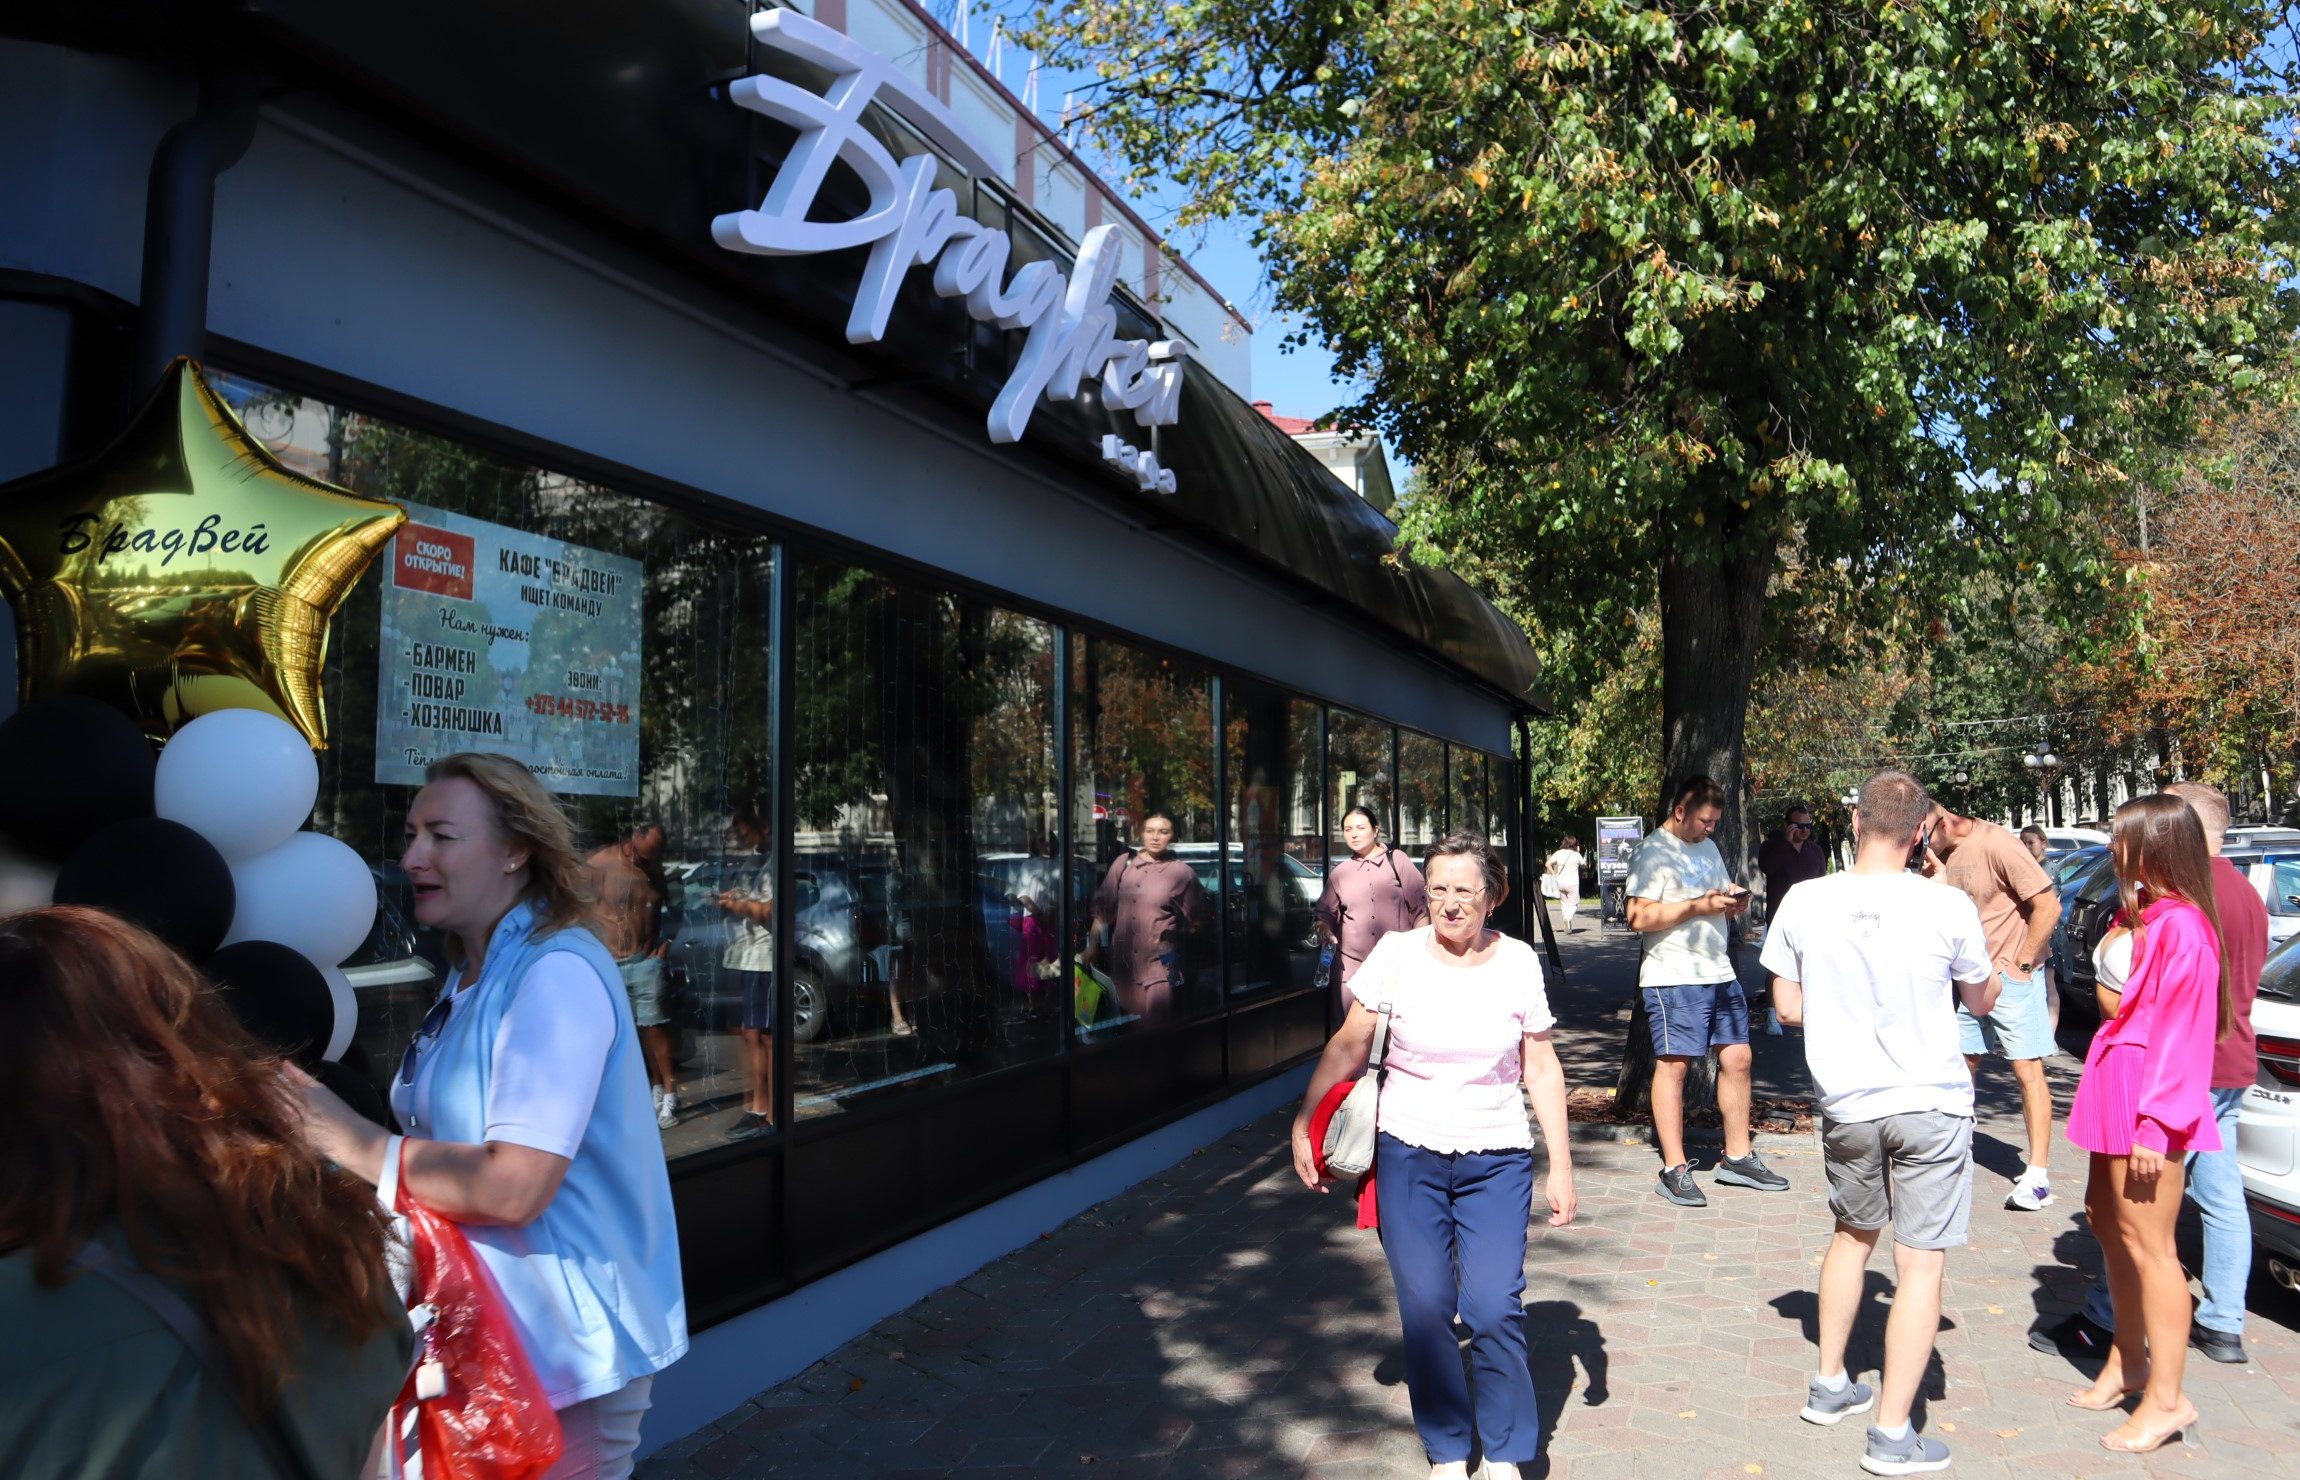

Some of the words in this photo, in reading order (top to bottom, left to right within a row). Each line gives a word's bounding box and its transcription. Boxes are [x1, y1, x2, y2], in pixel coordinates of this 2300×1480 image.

[416, 541, 452, 559] СКОРО
[404, 556, 465, 579] ОТКРЫТИЕ!
[499, 548, 541, 579] КАФЕ
[545, 558, 622, 595] "БРАДВЕЙ"
[520, 585, 550, 607] ИЩЕТ
[552, 592, 602, 617] КОМАНДУ
[439, 608, 477, 633] Нам
[481, 623, 530, 645] нужен:
[567, 670, 602, 691] ЗВОНИ:
[586, 765, 629, 780] оплата!
